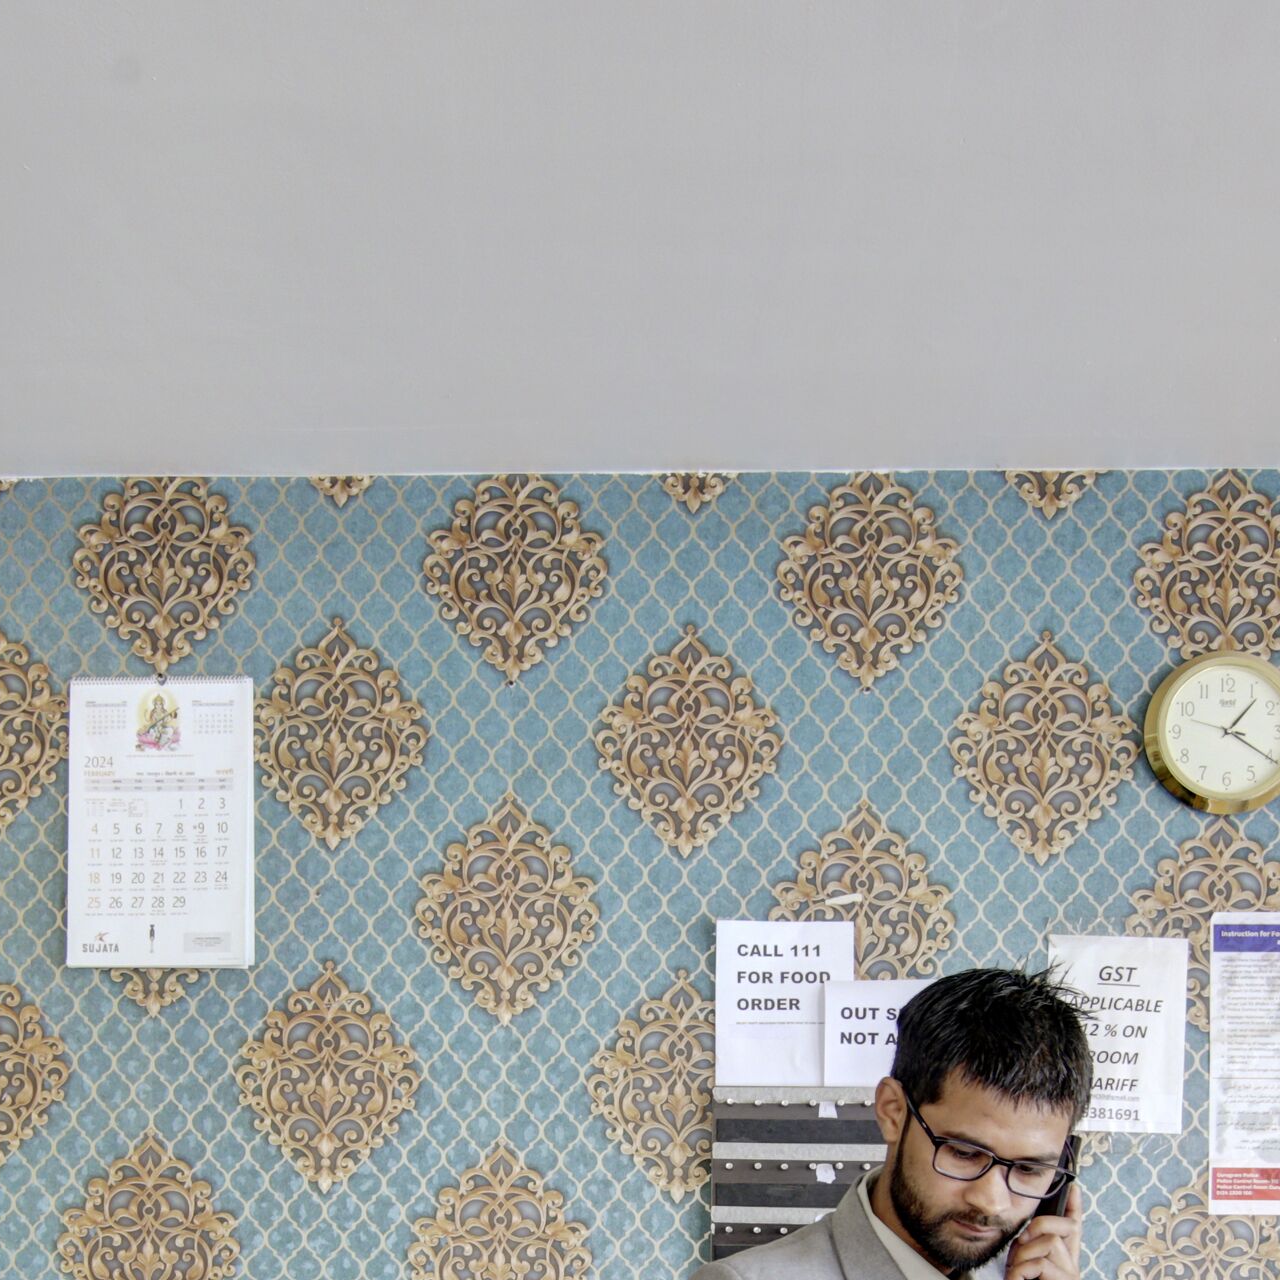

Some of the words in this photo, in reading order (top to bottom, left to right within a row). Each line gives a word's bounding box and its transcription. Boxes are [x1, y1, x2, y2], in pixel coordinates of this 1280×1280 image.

[1200, 684, 1208, 699] 11
[1221, 677, 1236, 693] 12
[1250, 683, 1254, 698] 1
[1180, 701, 1195, 717] 10
[1265, 700, 1275, 715] 2
[1171, 724, 1181, 739] 9
[83, 756, 113, 768] 2024
[1180, 748, 1190, 763] 8
[1265, 749, 1273, 764] 4
[1199, 765, 1207, 780] 7
[1222, 771, 1231, 787] 6
[1246, 765, 1256, 781] 5
[178, 798, 183, 809] 1
[198, 798, 205, 809] 2
[219, 797, 226, 809] 3
[91, 823, 98, 834] 4
[113, 823, 120, 835] 5
[135, 823, 142, 834] 6
[155, 822, 163, 834] 7
[176, 822, 184, 834] 8
[217, 821, 228, 833] 10
[90, 847, 100, 858] 11
[111, 847, 122, 859] 12
[134, 847, 144, 858] 13
[153, 847, 164, 858] 14
[174, 846, 185, 858] 15
[195, 846, 207, 858] 16
[217, 846, 227, 857] 17
[89, 872, 100, 884] 18
[111, 872, 122, 884] 19
[131, 872, 145, 884] 20
[153, 872, 164, 883] 21
[173, 872, 186, 883] 22
[194, 871, 207, 883] 23
[215, 871, 227, 883] 24
[87, 896, 101, 909] 25
[109, 896, 123, 909] 26
[131, 896, 144, 909] 27
[152, 896, 165, 908] 28
[172, 896, 186, 908] 29
[82, 943, 119, 953] SUJATA
[737, 944, 783, 957] CALL
[790, 944, 821, 957] 111
[737, 971, 773, 984] FOR
[780, 971, 831, 984] FOOD
[1098, 965, 1137, 982] GST
[737, 998, 801, 1011] ORDER
[1070, 995, 1164, 1013] APPLICABLE
[840, 1007, 880, 1020] OUT
[1104, 1024, 1118, 1037] %
[1122, 1025, 1148, 1038] ON
[840, 1032, 879, 1045] NOT
[1090, 1077, 1139, 1091] ARIFF
